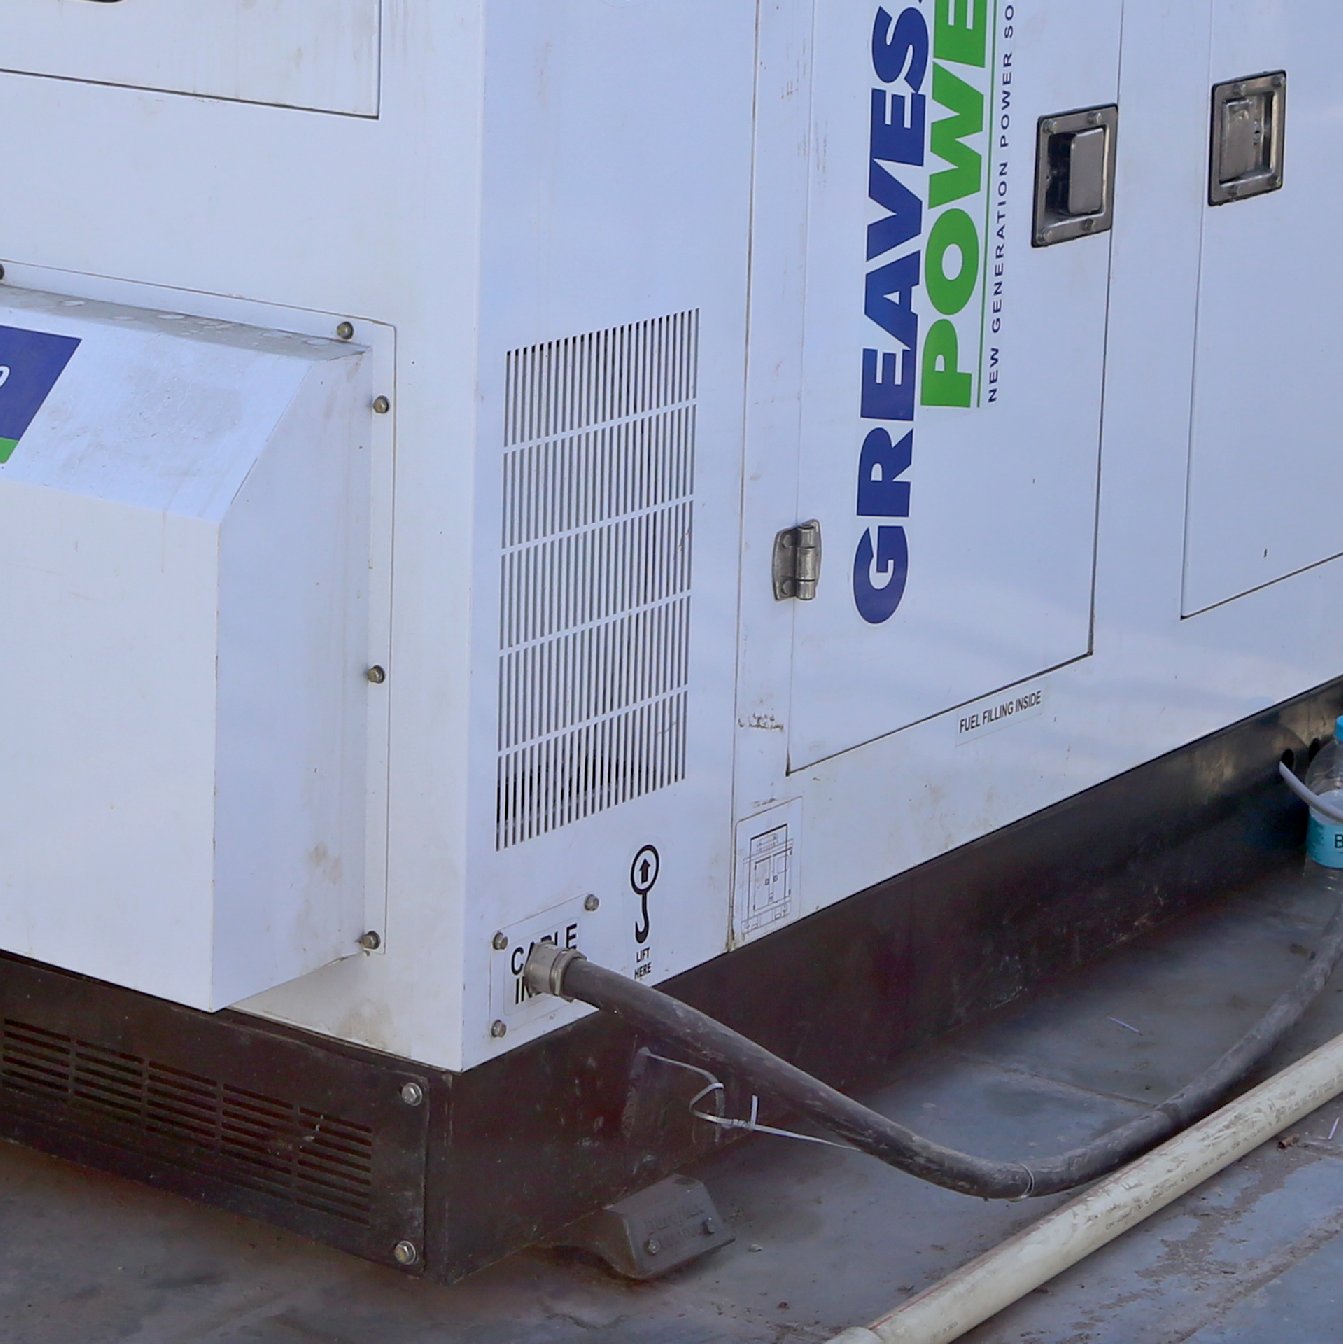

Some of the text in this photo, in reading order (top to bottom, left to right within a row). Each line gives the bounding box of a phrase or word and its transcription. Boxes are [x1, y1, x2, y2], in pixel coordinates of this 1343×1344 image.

[1000, 53, 1013, 147] POWER
[992, 161, 1008, 333] GENERATION
[853, 6, 929, 624] GREAVES
[988, 347, 998, 403] NEW
[959, 690, 1042, 734] FUEL FILLING INSIDE
[634, 963, 652, 980] HERE
[635, 947, 651, 963] LIFT
